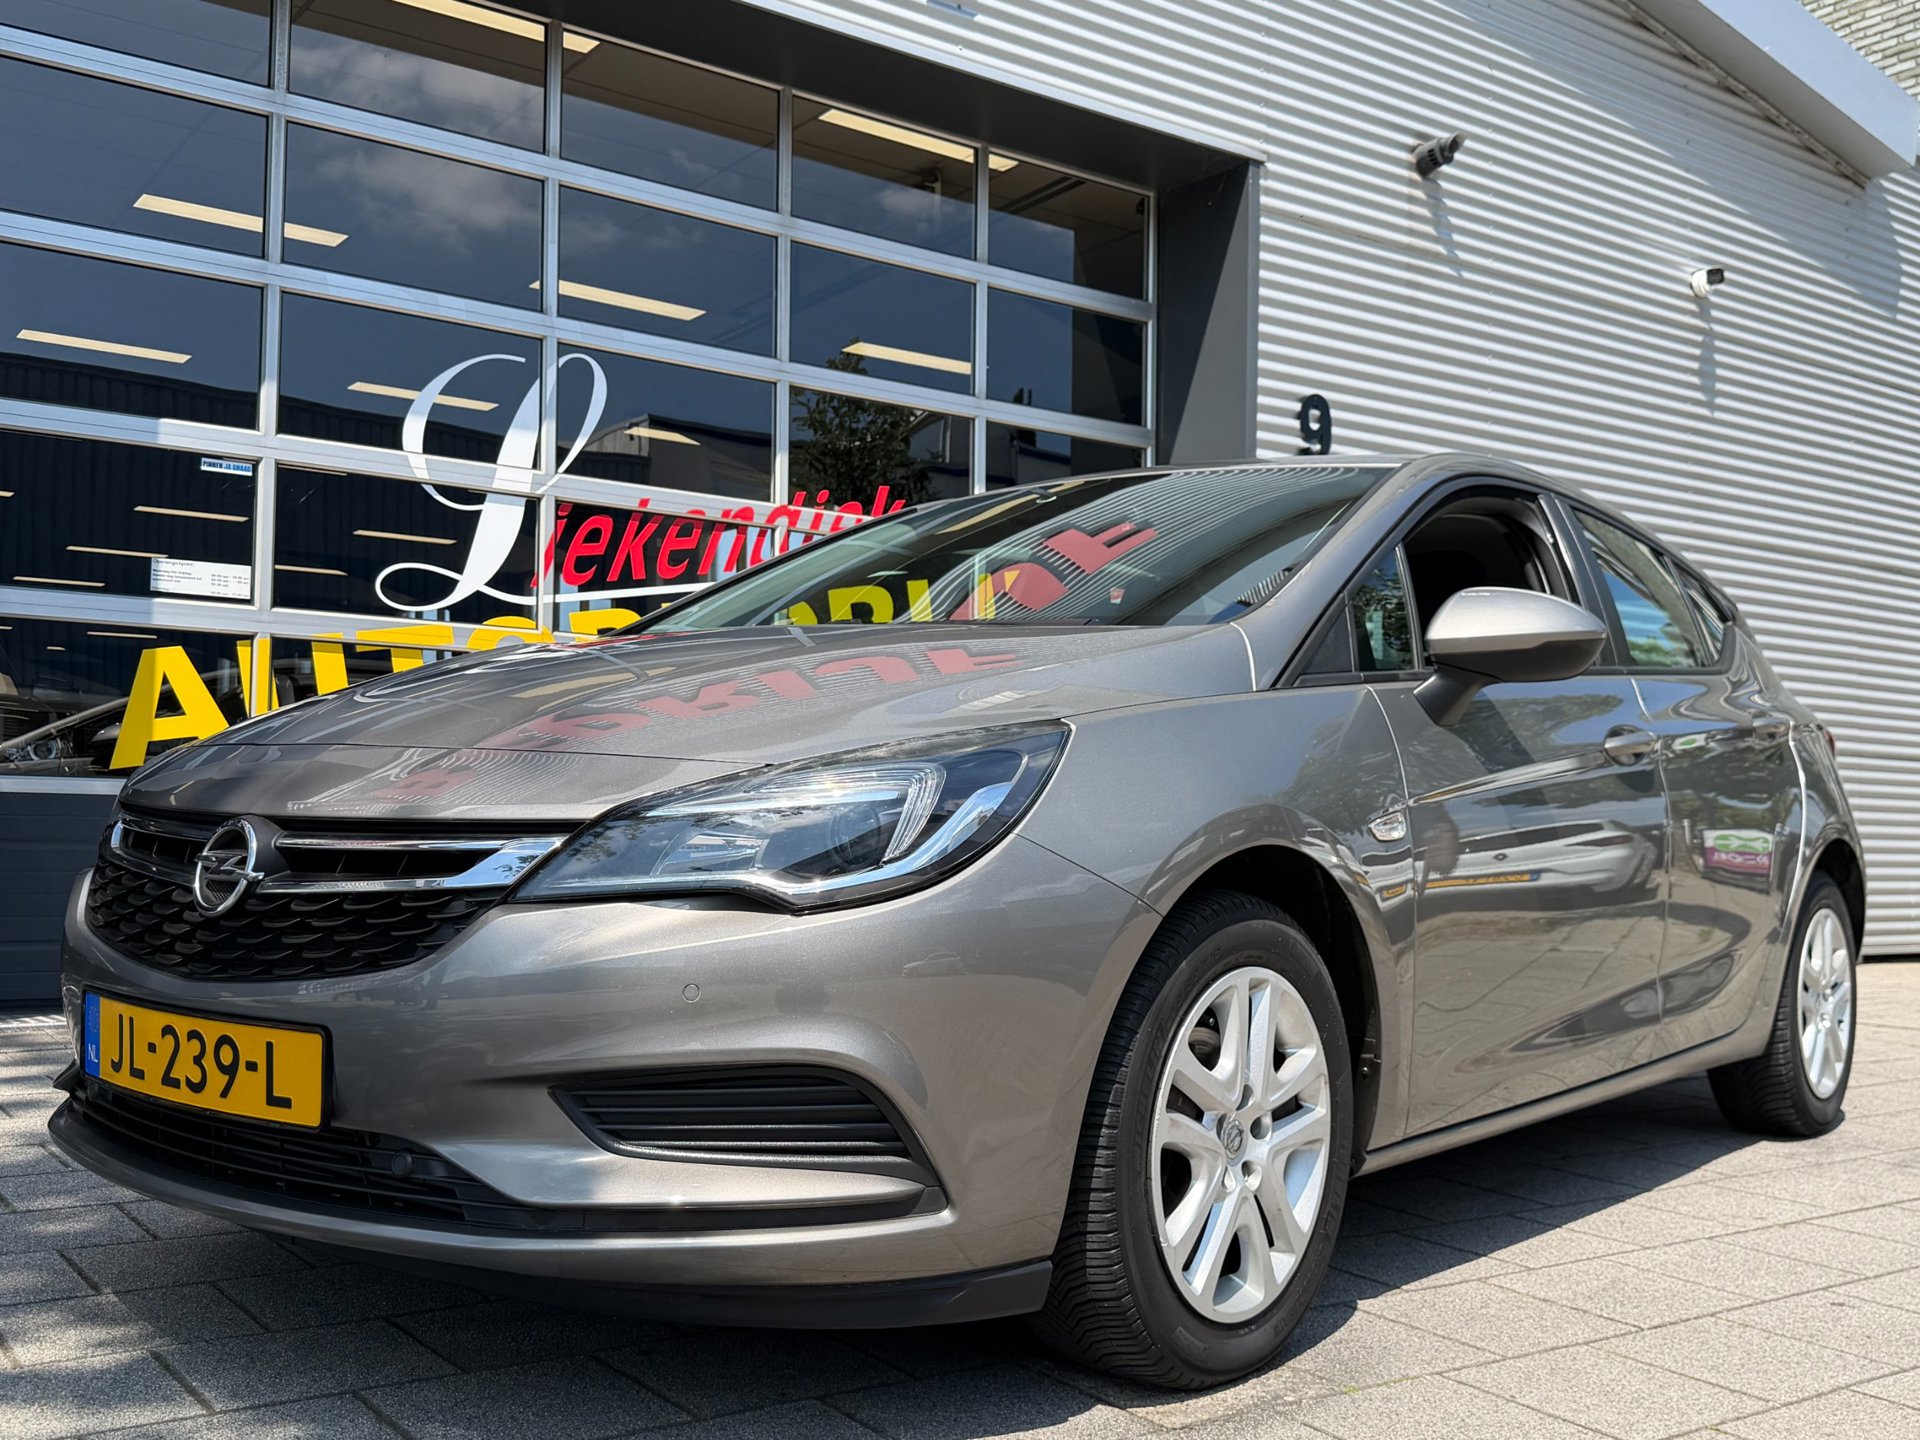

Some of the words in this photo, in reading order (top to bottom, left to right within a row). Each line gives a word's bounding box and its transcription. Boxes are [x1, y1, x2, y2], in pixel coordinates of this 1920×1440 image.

[1300, 394, 1331, 455] 9
[88, 1046, 98, 1063] NL
[111, 1013, 292, 1109] JL-239-L
